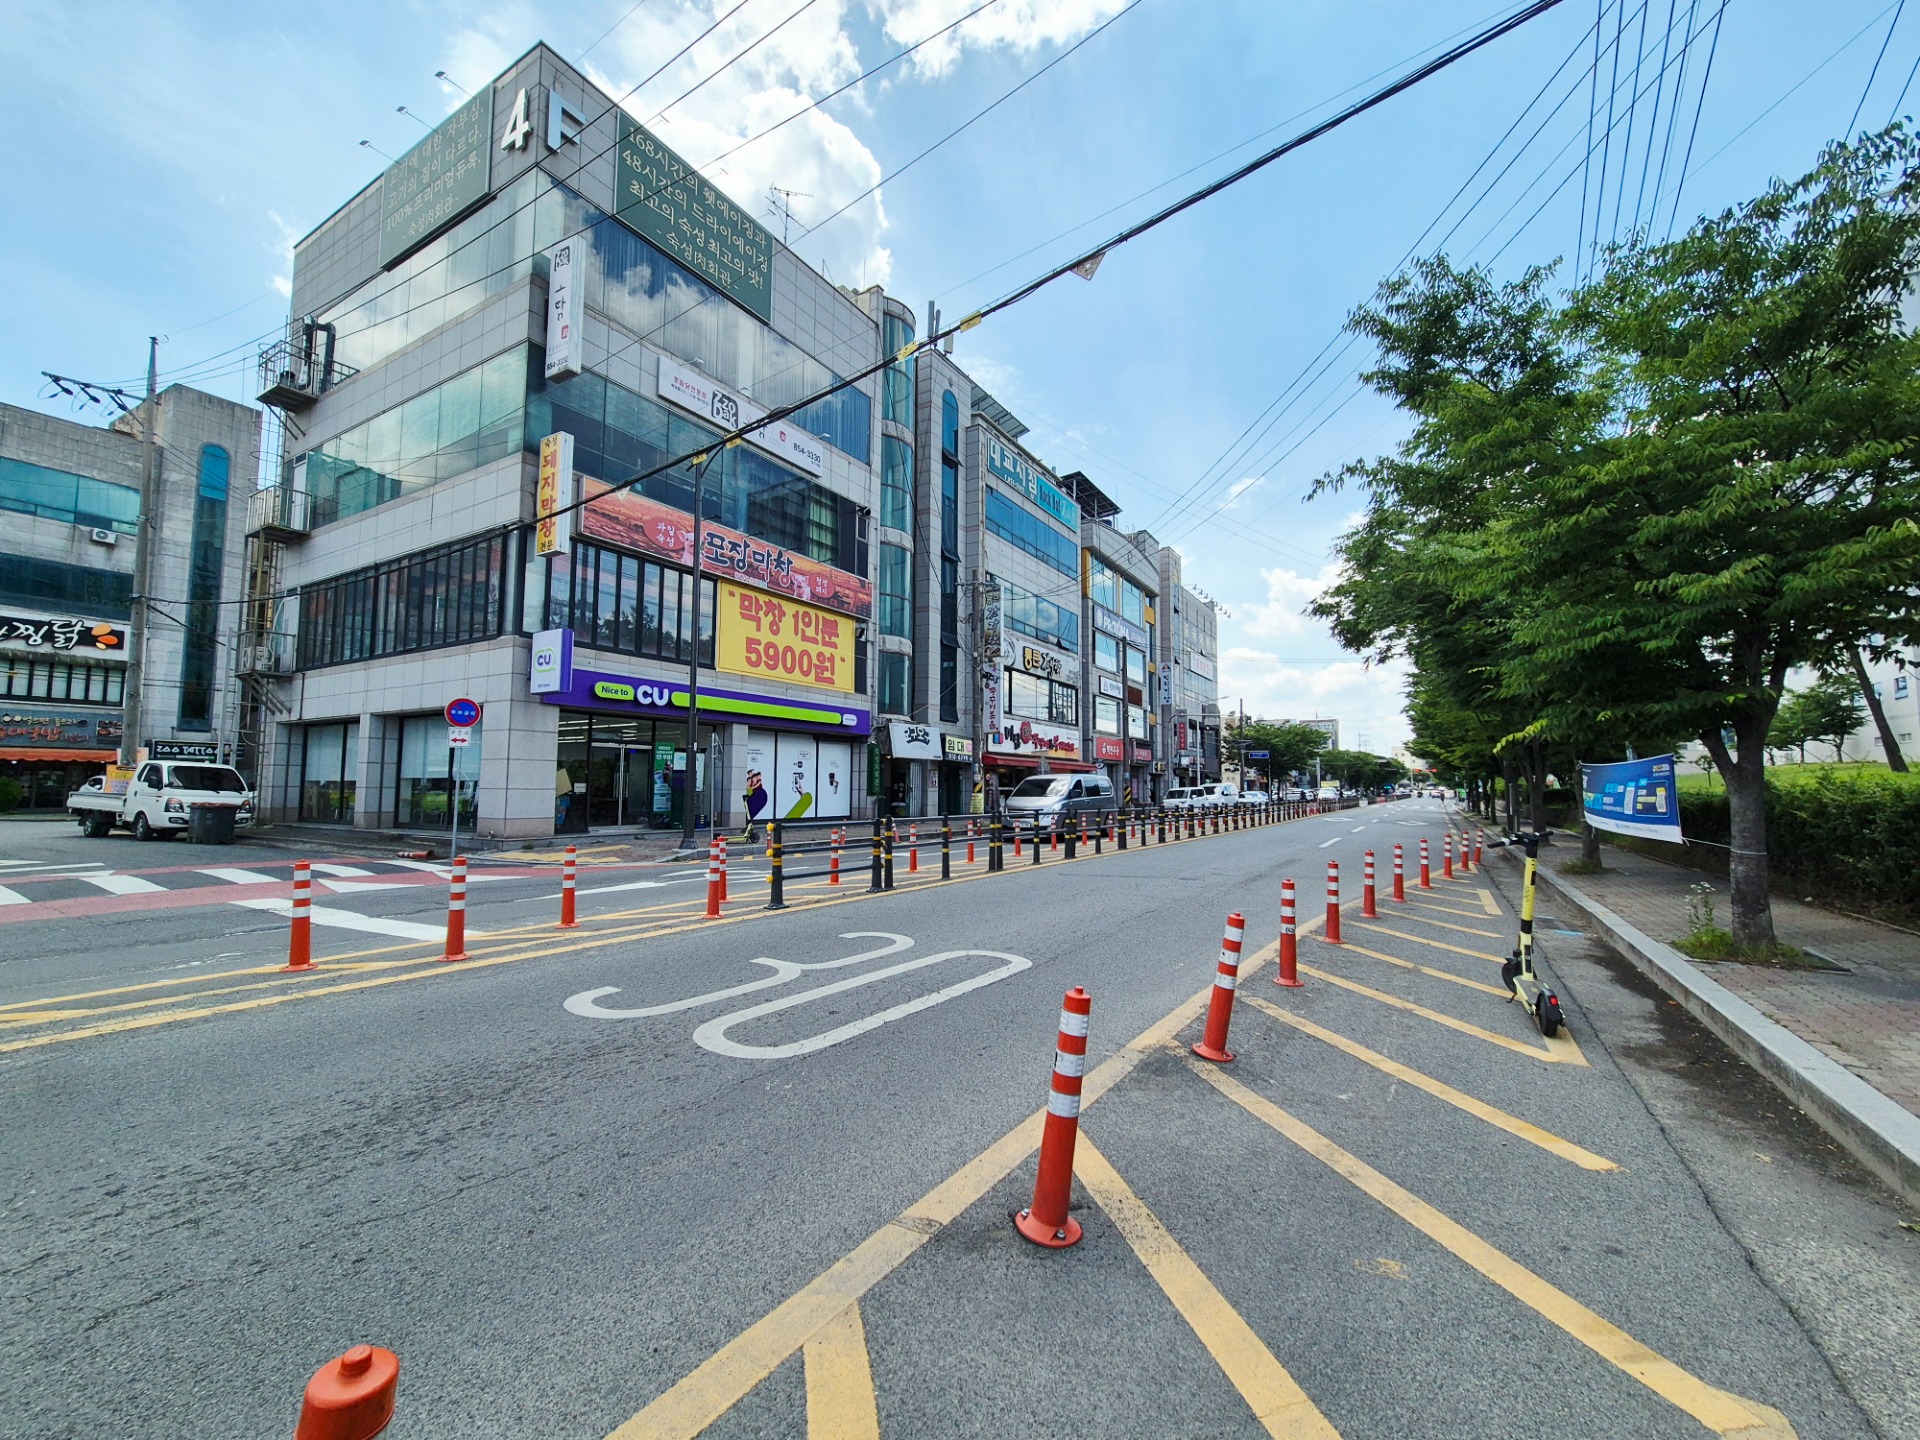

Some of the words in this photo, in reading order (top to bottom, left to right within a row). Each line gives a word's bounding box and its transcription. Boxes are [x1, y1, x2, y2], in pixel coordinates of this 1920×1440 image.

[388, 173, 418, 210] 고기의
[421, 153, 442, 184] 질이
[389, 151, 419, 186] 고기에
[422, 131, 443, 158] 대한
[628, 126, 698, 196] 168시간의
[622, 150, 688, 211] 48시간의
[691, 202, 768, 273] 드라이에이징
[630, 179, 675, 226] 최고의
[678, 218, 705, 247] 숙성
[708, 238, 745, 276] 최고의
[793, 442, 821, 464] 854-3330
[539, 448, 557, 538] 돼지막창
[537, 653, 552, 667] CU
[601, 685, 619, 695] Nice
[620, 688, 629, 696] to
[637, 685, 669, 707] CU
[947, 739, 965, 753] 임대
